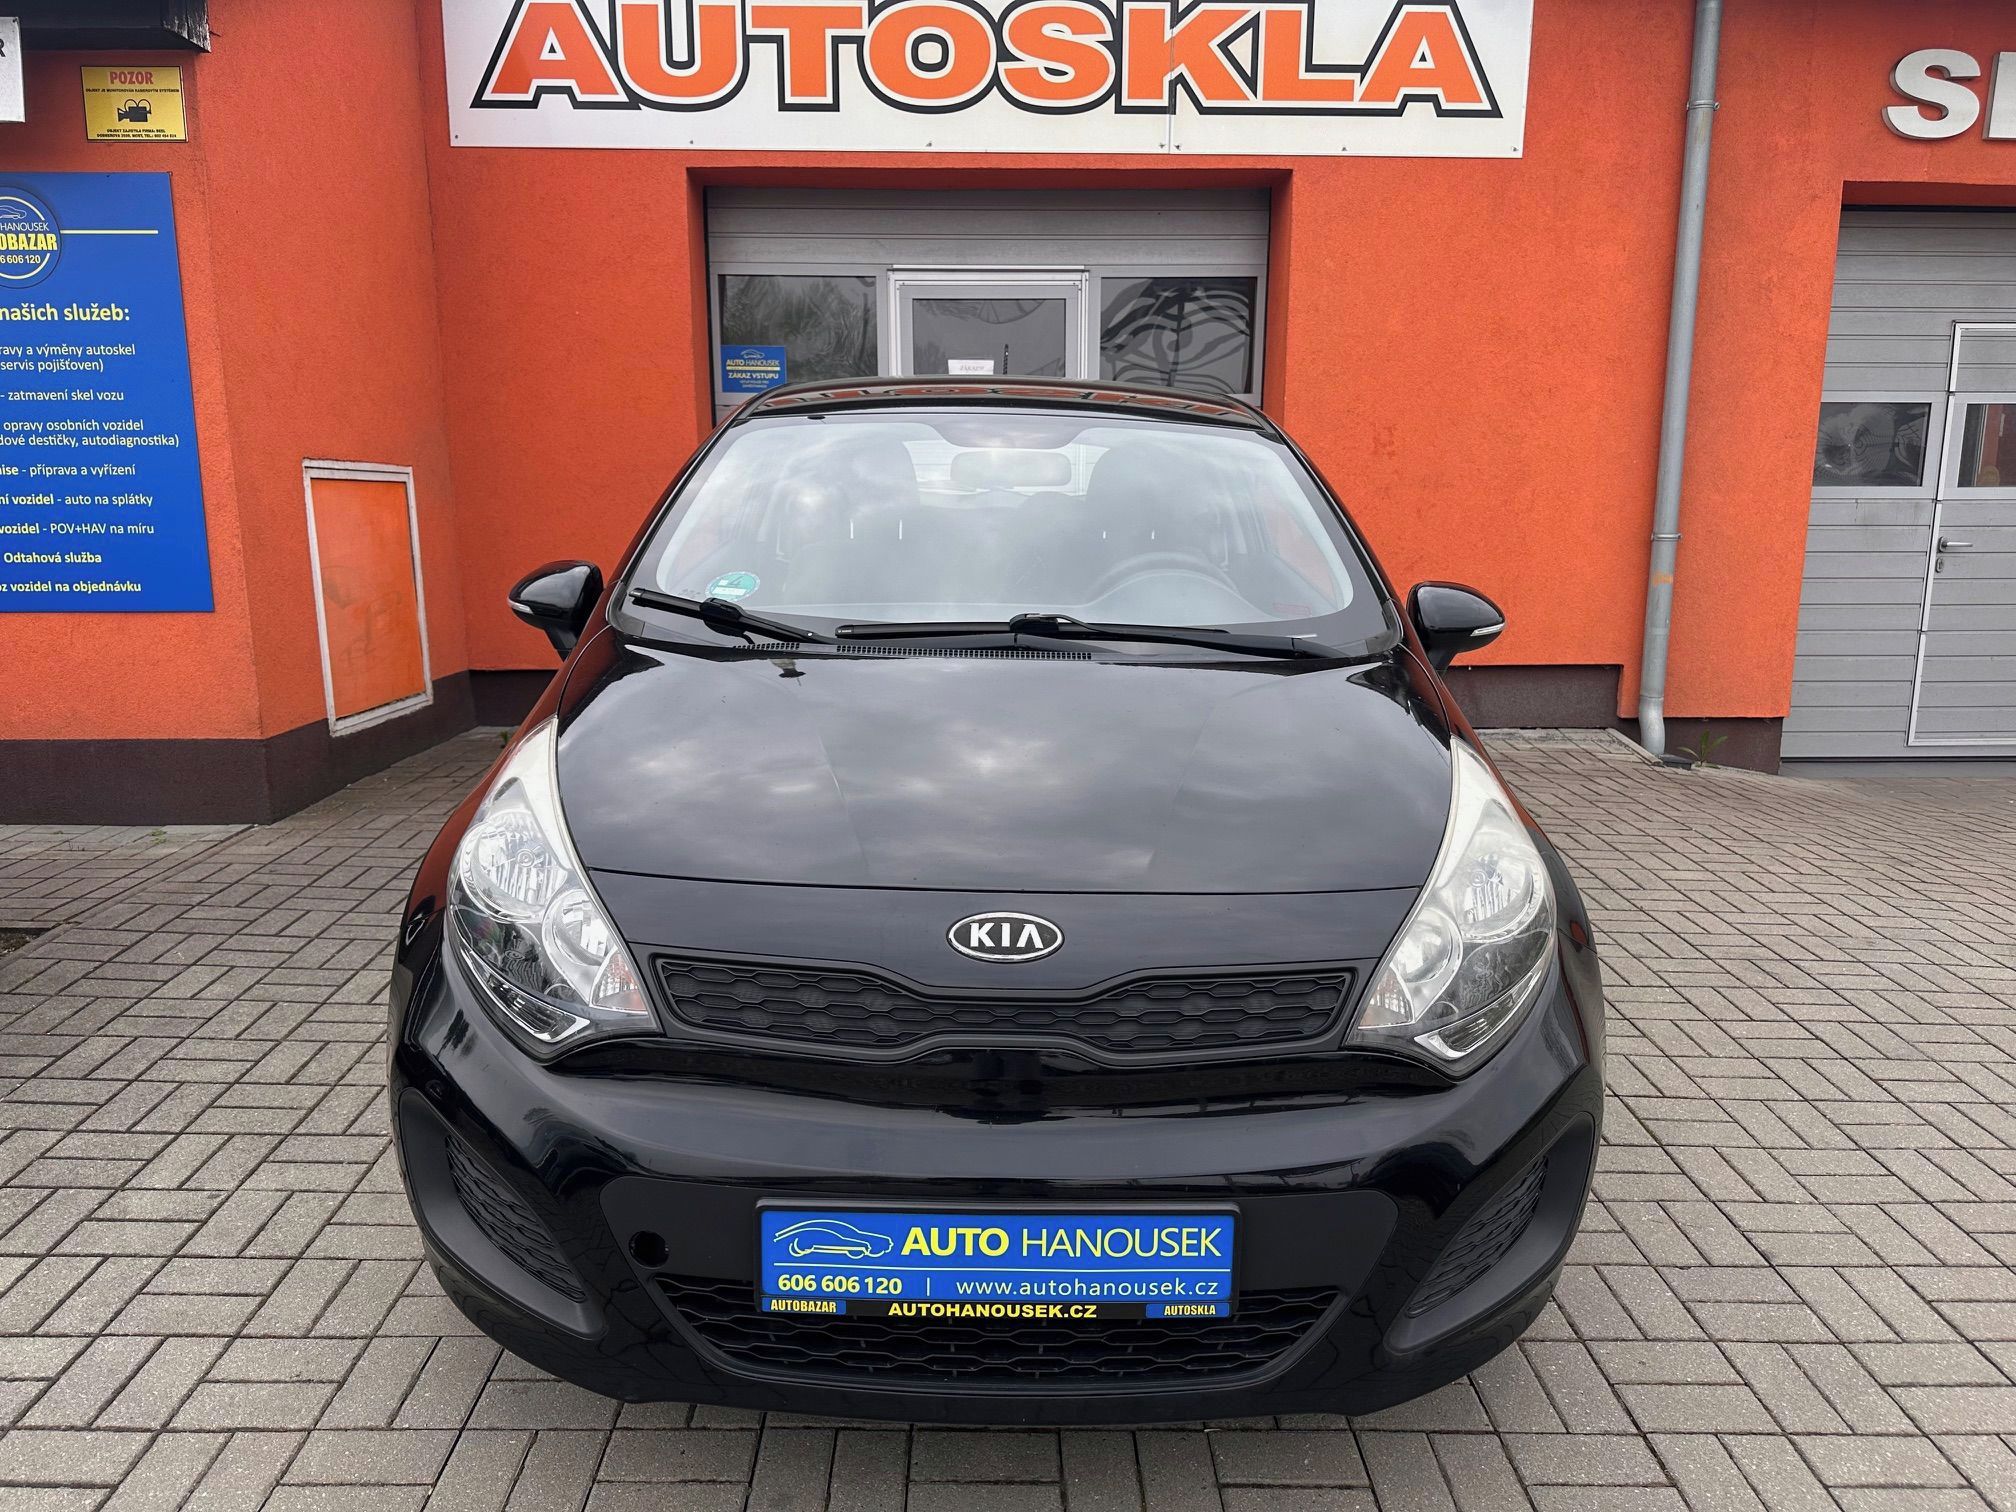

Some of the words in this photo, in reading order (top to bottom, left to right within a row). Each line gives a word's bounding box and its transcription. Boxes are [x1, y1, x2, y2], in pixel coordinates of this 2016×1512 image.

[469, 0, 1502, 118] AUTOSKLA
[110, 71, 154, 85] POZOR
[0, 222, 49, 231] HANOUSEK
[7, 255, 24, 264] 606
[25, 255, 41, 264] 120
[0, 303, 58, 321] našich
[64, 303, 130, 321] služeb:
[26, 346, 33, 355] a
[36, 343, 82, 358] výměny
[86, 344, 135, 355] autoskel
[1, 360, 34, 370] servis
[38, 359, 104, 372] pojišťoven)
[8, 389, 68, 400] zatmavení
[71, 389, 94, 400] skel
[97, 391, 124, 400] vozu
[3, 421, 43, 433] opravy
[46, 419, 99, 430] osobních
[102, 419, 144, 430] vozidel
[28, 434, 79, 448] destičky,
[82, 434, 179, 447] autodiagnostika)
[30, 464, 77, 478] příprava
[81, 467, 88, 475] a
[90, 464, 136, 478] vyřízení
[12, 493, 54, 505] vozidel
[65, 495, 92, 505] auto
[95, 496, 109, 505] na
[112, 493, 153, 507] splátky
[51, 523, 106, 534] POV+HAV
[110, 525, 124, 534] na
[128, 523, 154, 534] míru
[3, 552, 62, 563] Odtahová
[65, 552, 102, 563] služba
[11, 581, 52, 592] vozidel
[55, 583, 70, 592] na
[73, 581, 142, 594] objednávku
[970, 923, 1044, 948] KIA
[901, 1227, 1010, 1256] AUTO
[1022, 1227, 1222, 1258] HANOUSEK
[778, 1275, 817, 1292] 606
[821, 1275, 861, 1293] 606
[865, 1276, 903, 1294] 120
[956, 1278, 1219, 1297] www.autohanousek.cz
[771, 1300, 837, 1313] AUTOBAZAR
[888, 1303, 1097, 1318] AUTOHANOUSEK.CZ
[1164, 1304, 1216, 1316] AUTOSKLA
